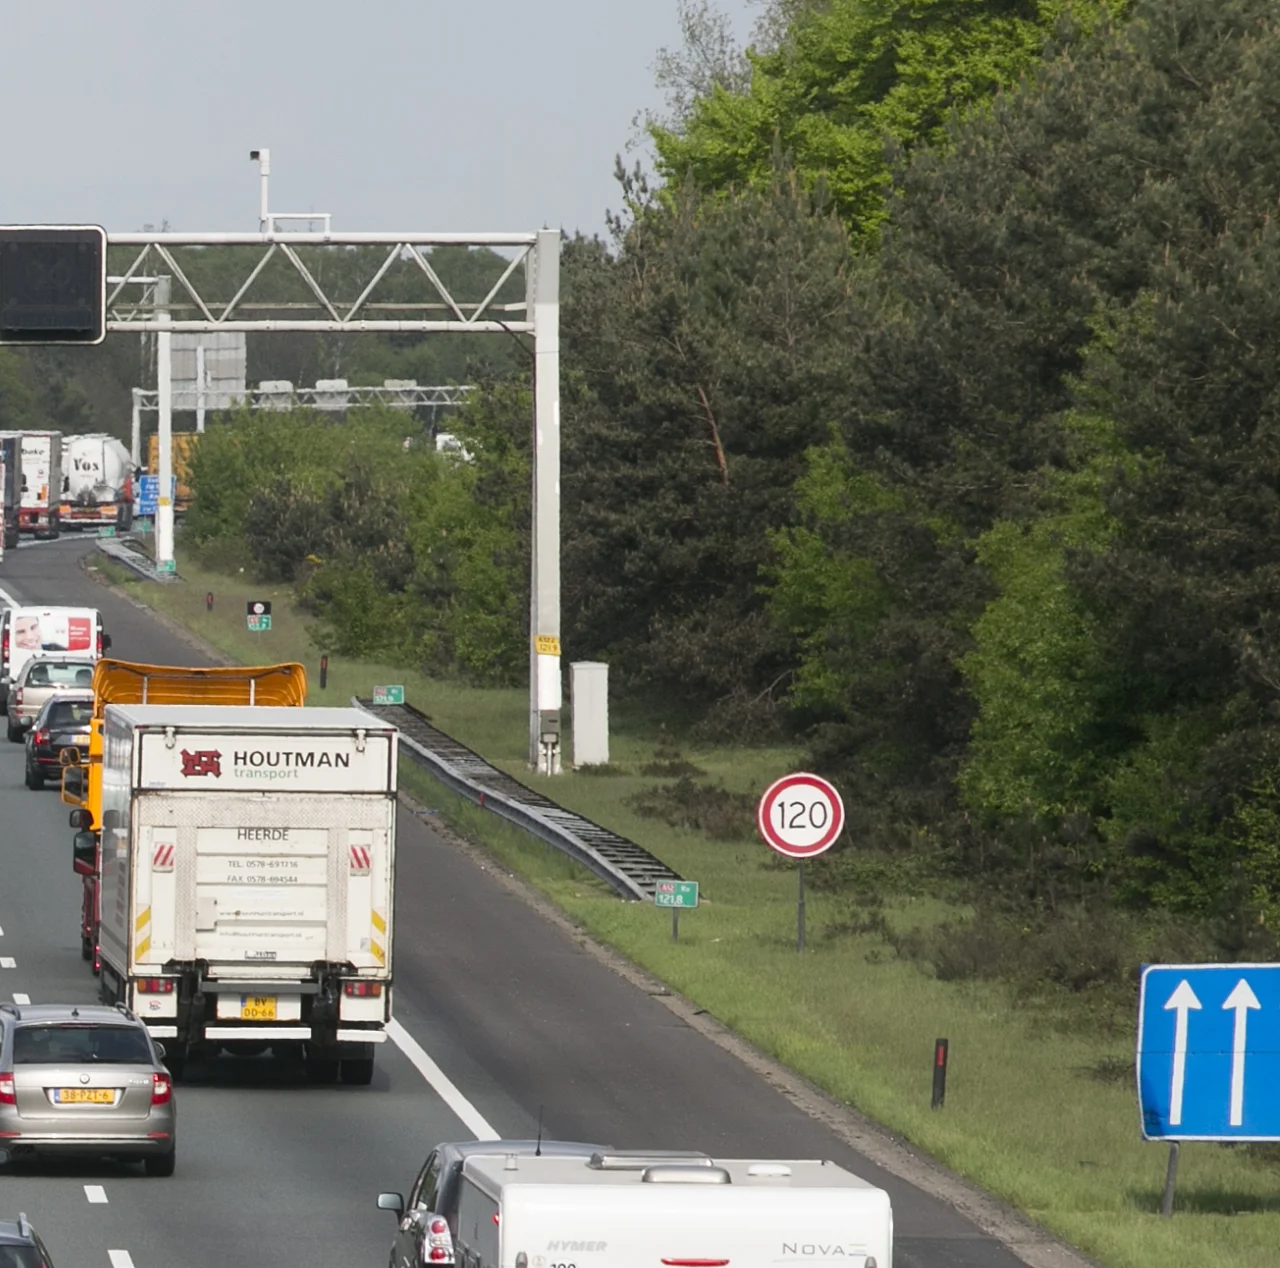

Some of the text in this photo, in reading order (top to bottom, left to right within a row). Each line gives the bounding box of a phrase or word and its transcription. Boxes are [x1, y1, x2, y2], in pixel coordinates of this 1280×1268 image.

[234, 751, 351, 768] HOUTMAN
[234, 767, 299, 780] transport
[778, 801, 828, 829] 120
[237, 827, 289, 841] HEERDE
[254, 998, 267, 1007] BV
[63, 1091, 109, 1101] 38-PZT-6
[546, 1241, 608, 1252] HYMER
